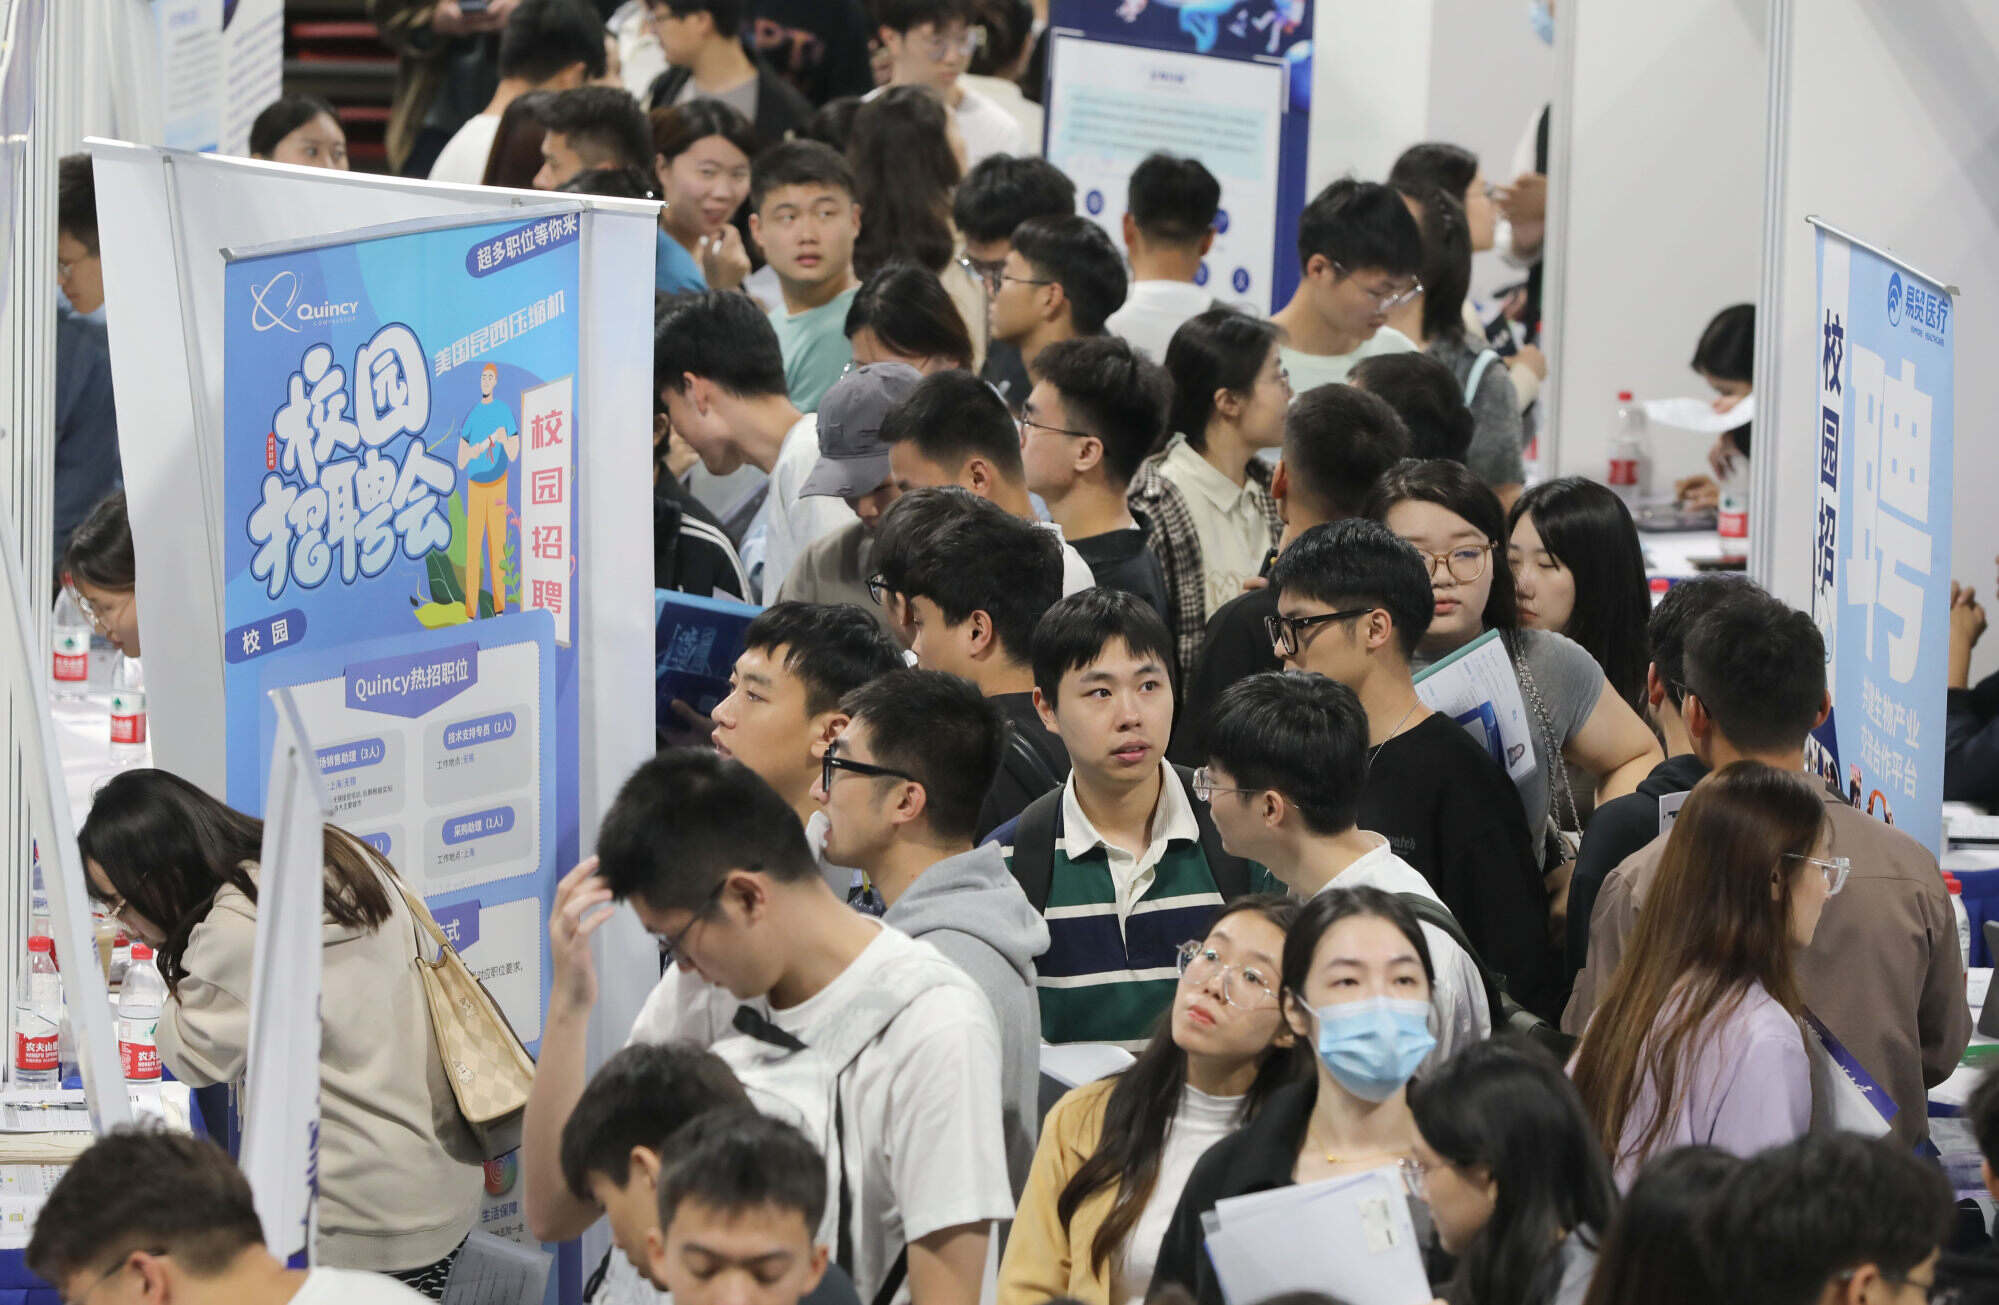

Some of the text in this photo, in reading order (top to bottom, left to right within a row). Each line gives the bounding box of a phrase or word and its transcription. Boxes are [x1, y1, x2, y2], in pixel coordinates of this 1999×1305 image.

[476, 213, 578, 272] 超多职位等你来
[296, 300, 359, 321] Quincy
[434, 289, 565, 377] 美国昆西压缩机
[272, 322, 431, 485] 校园
[246, 436, 457, 600] 招聘会
[530, 409, 564, 614] 校园招聘
[1846, 343, 1933, 684] 聘
[242, 619, 289, 655] 校园
[354, 658, 469, 702] Quincy热招职位
